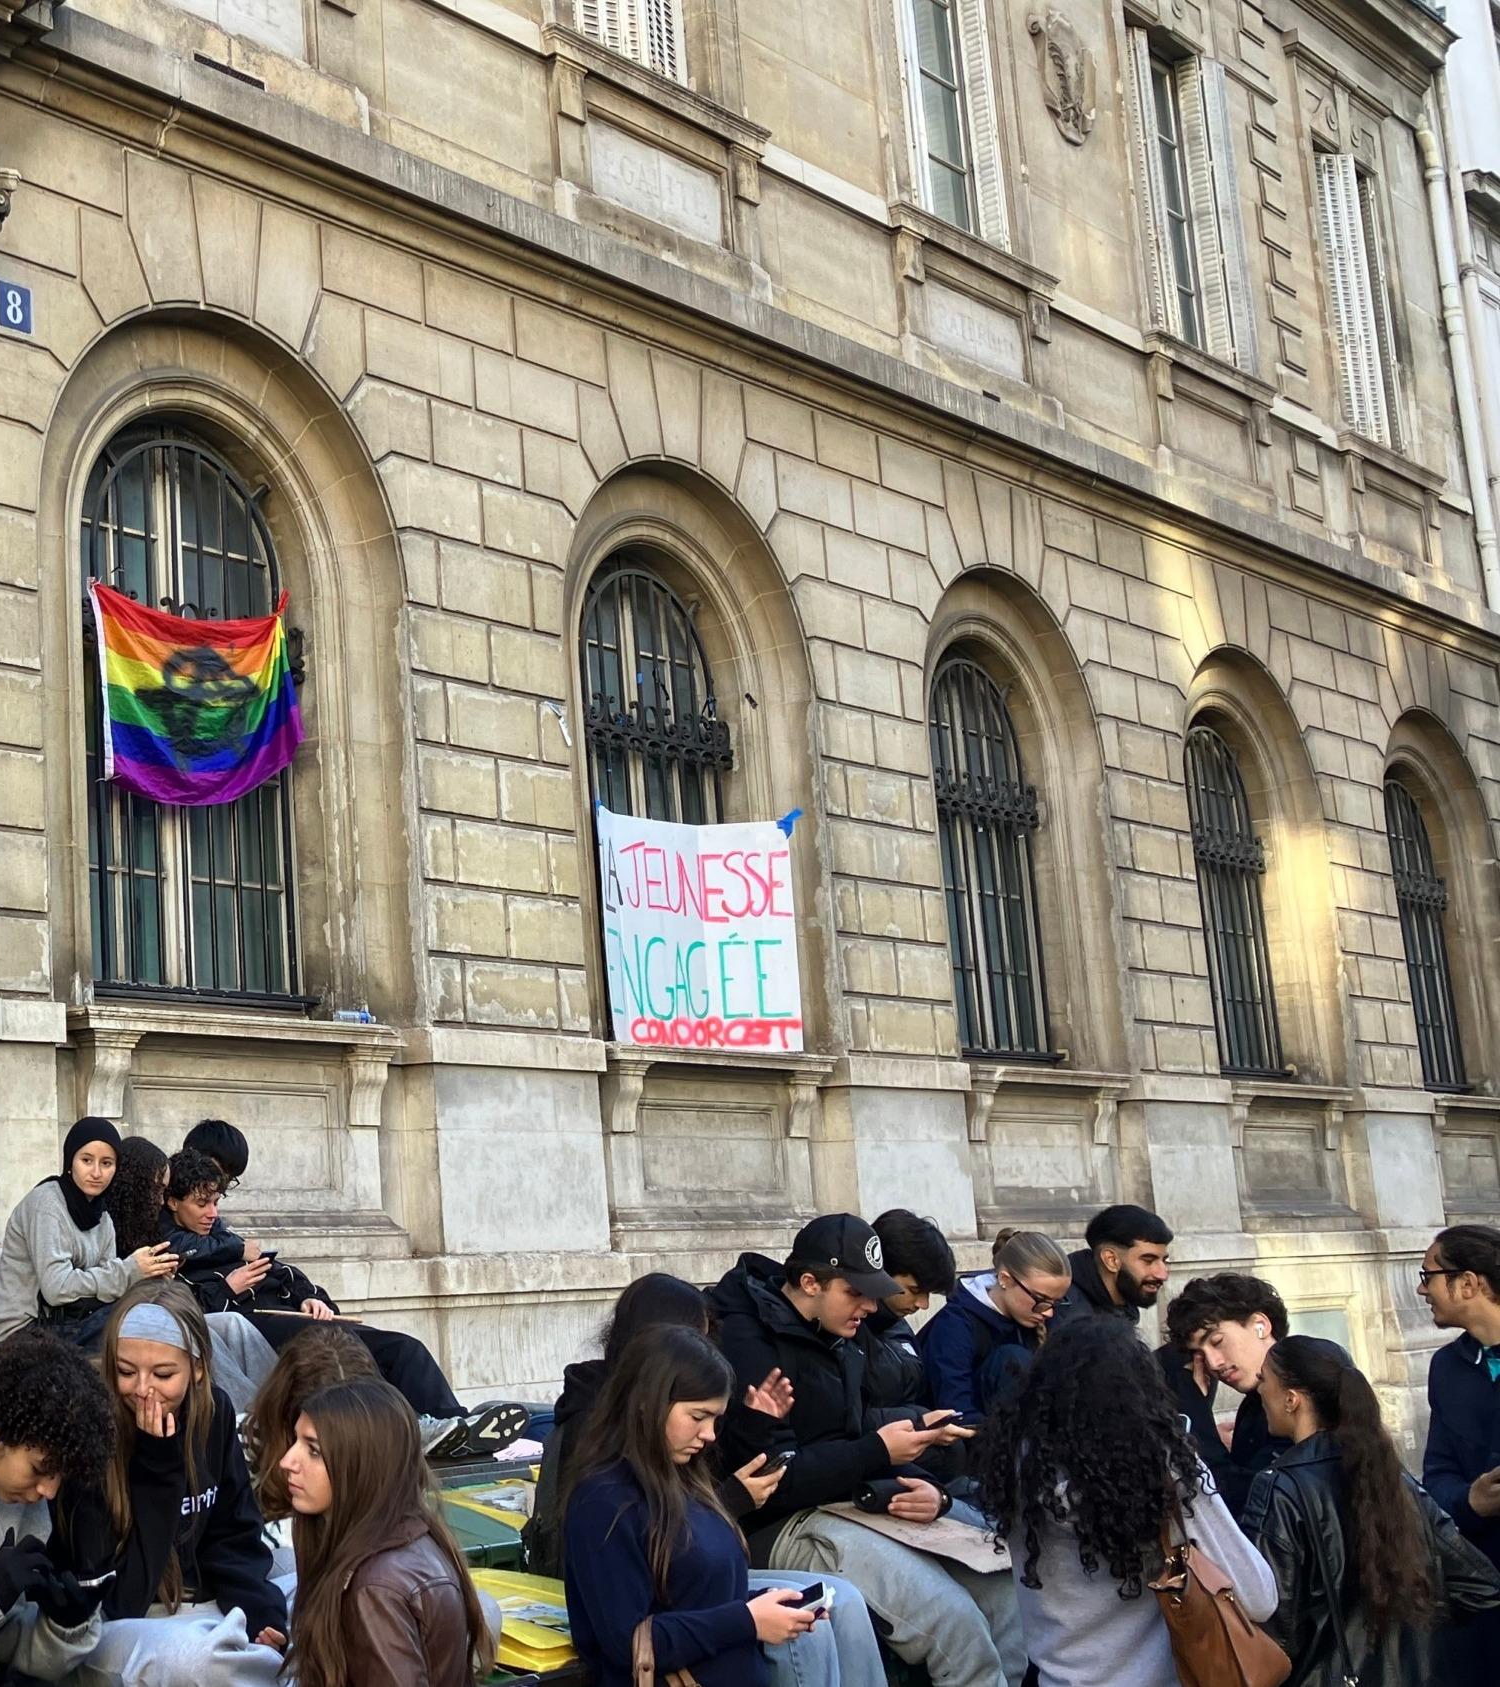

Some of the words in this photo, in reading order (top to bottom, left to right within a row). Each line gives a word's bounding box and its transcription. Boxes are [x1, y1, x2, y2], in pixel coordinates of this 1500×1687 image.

[7, 290, 23, 324] 8
[599, 837, 624, 914] LA
[620, 841, 793, 923] JEUNESSE
